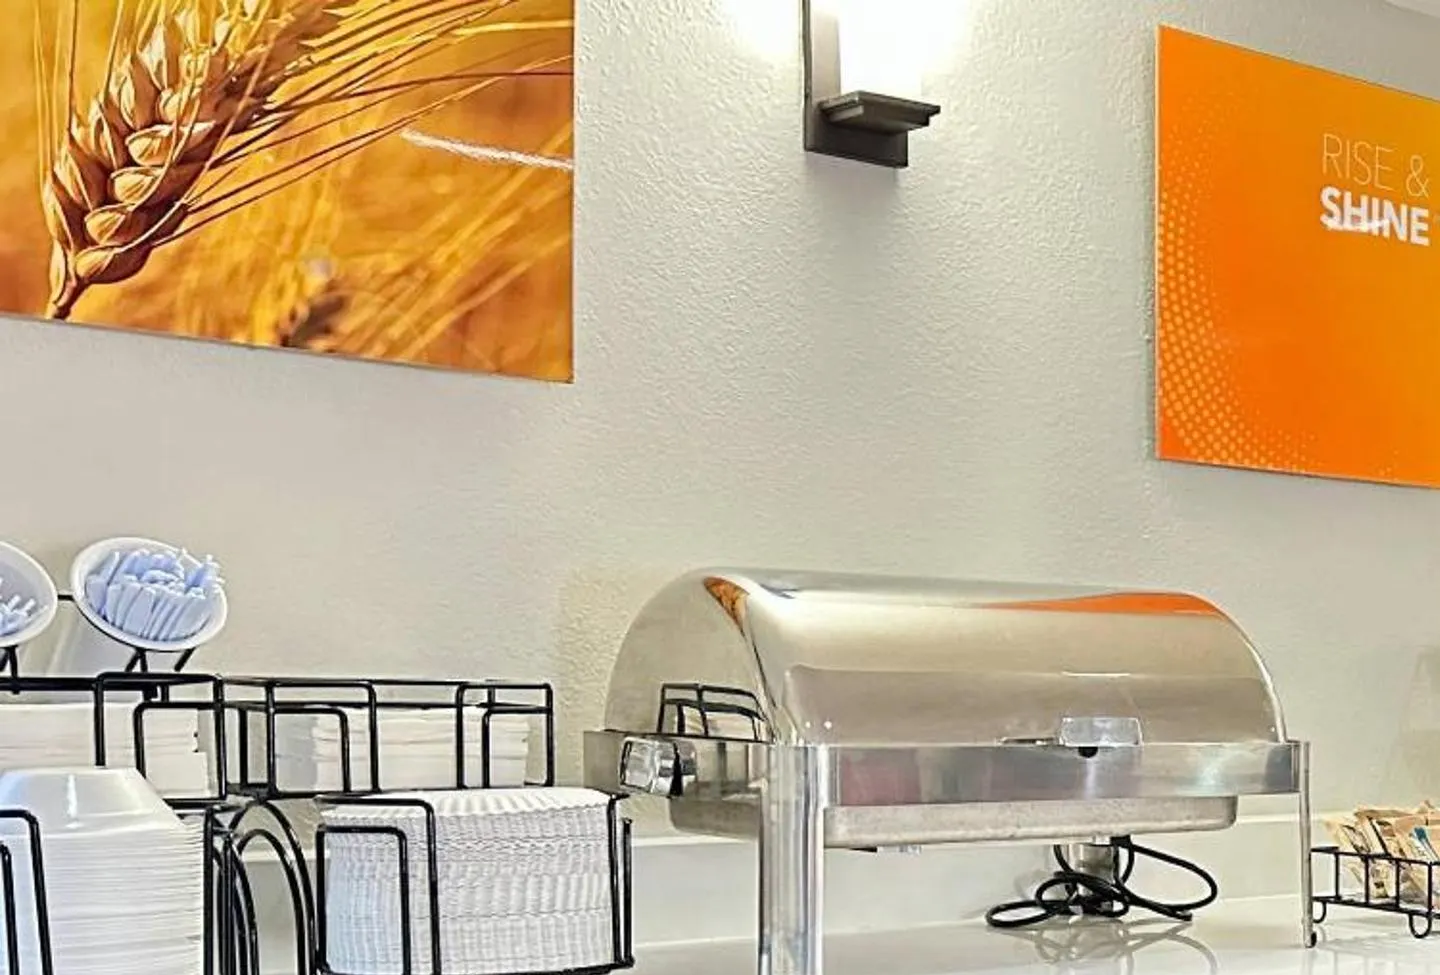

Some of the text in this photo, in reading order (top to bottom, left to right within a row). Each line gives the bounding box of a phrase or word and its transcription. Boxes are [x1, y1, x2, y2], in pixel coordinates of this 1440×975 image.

[1323, 132, 1430, 199] RISE &
[1320, 186, 1430, 246] SHINE
